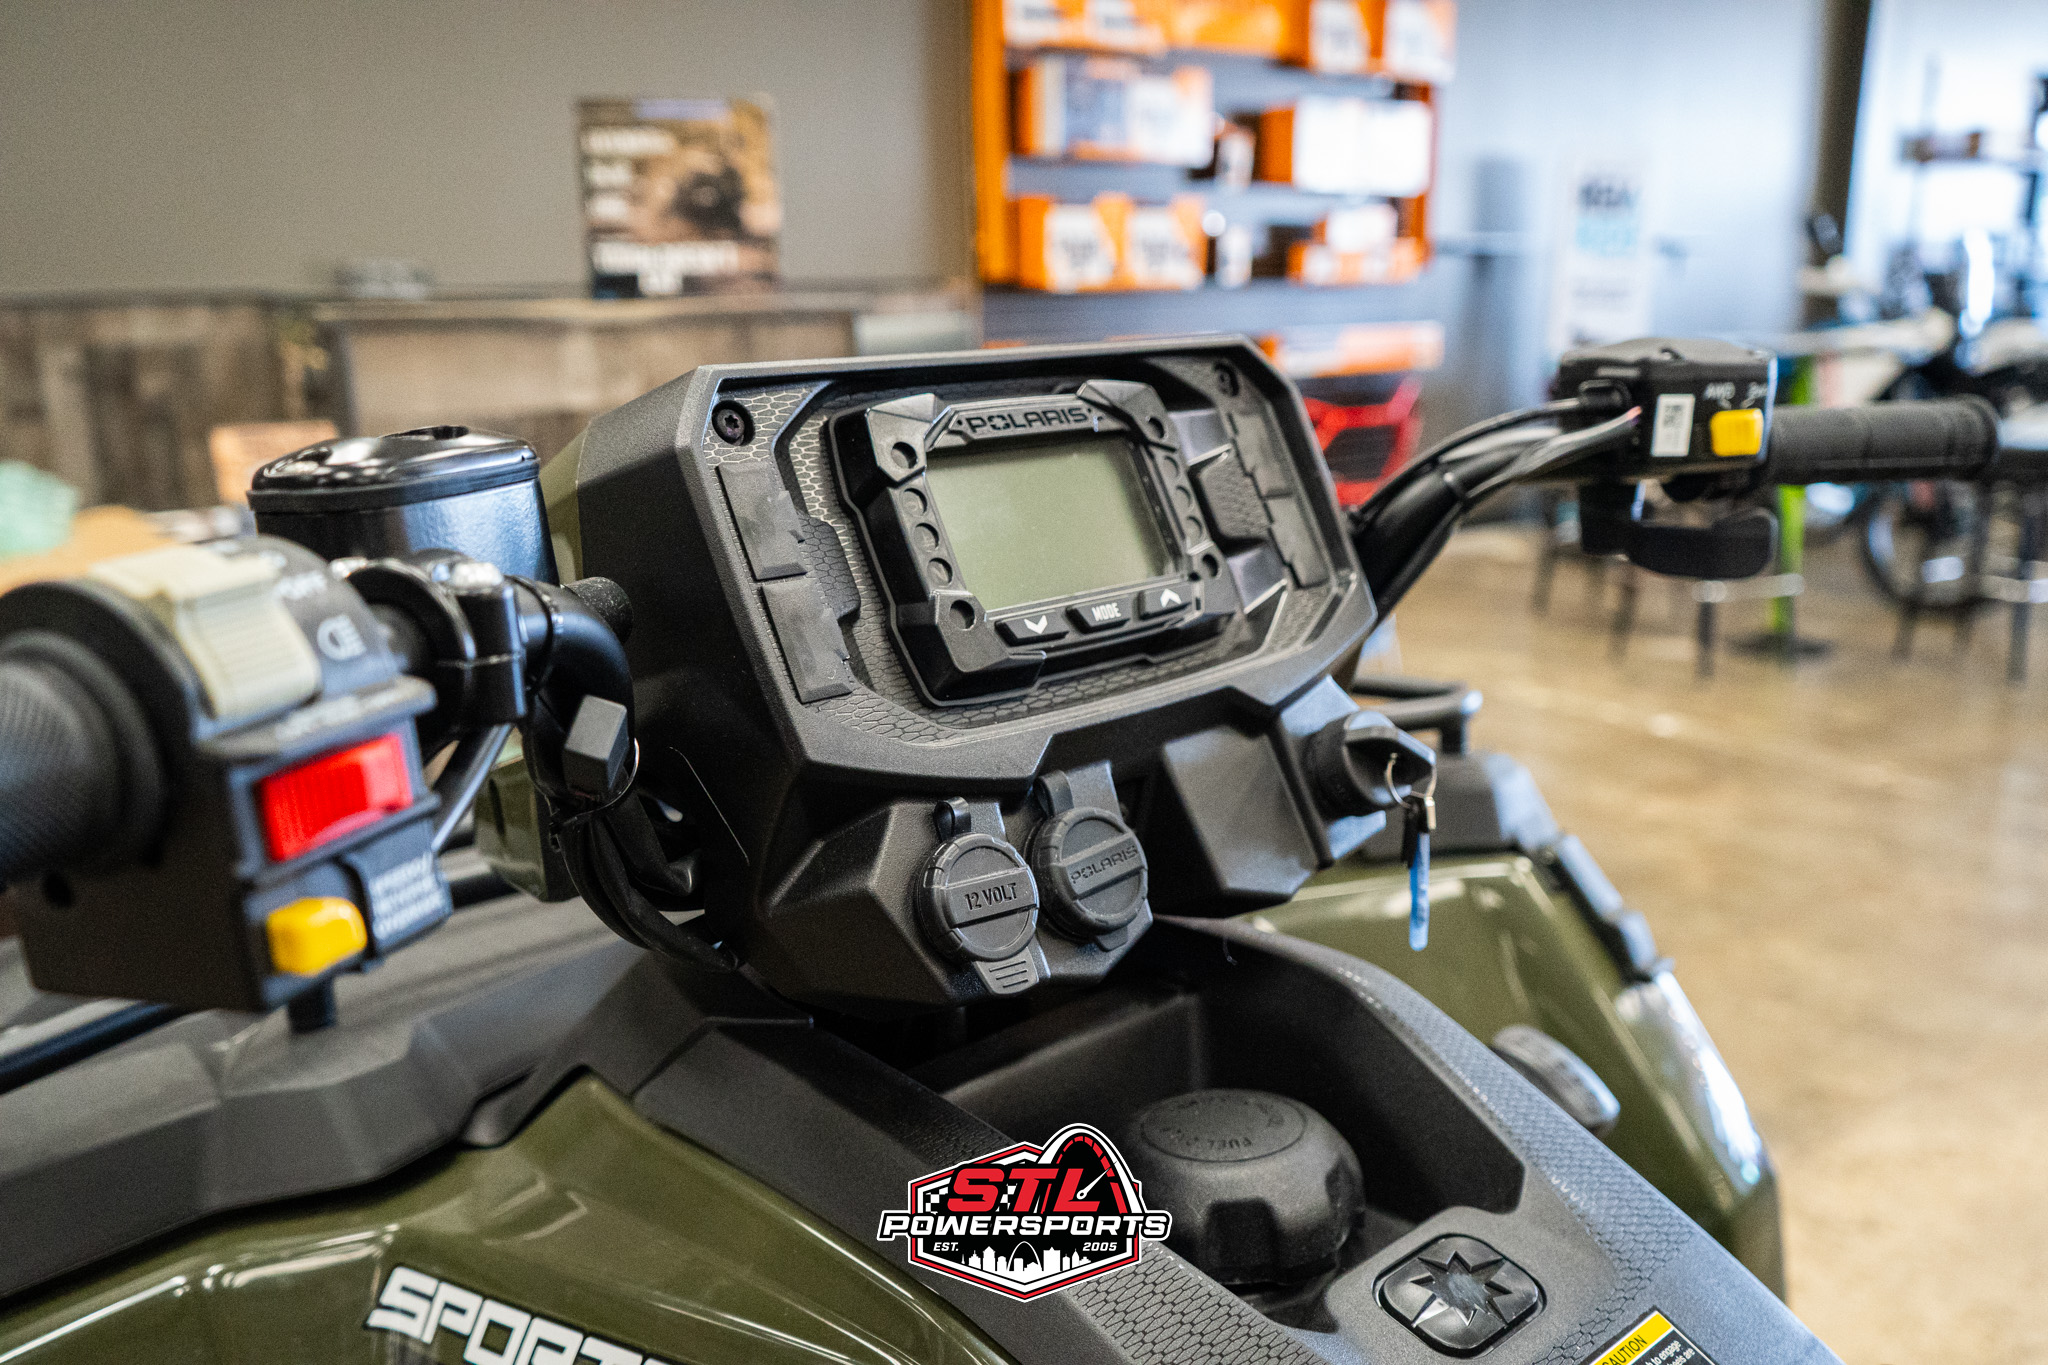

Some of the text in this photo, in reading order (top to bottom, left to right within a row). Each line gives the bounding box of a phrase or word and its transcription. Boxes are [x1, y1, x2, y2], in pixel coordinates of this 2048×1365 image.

[966, 406, 1087, 433] POLARIS
[1091, 602, 1122, 622] MODE
[1070, 844, 1139, 885] POLARIS
[964, 882, 1018, 910] 12 VOLT
[1659, 1340, 1681, 1361] engage
[1683, 1348, 1695, 1360] are
